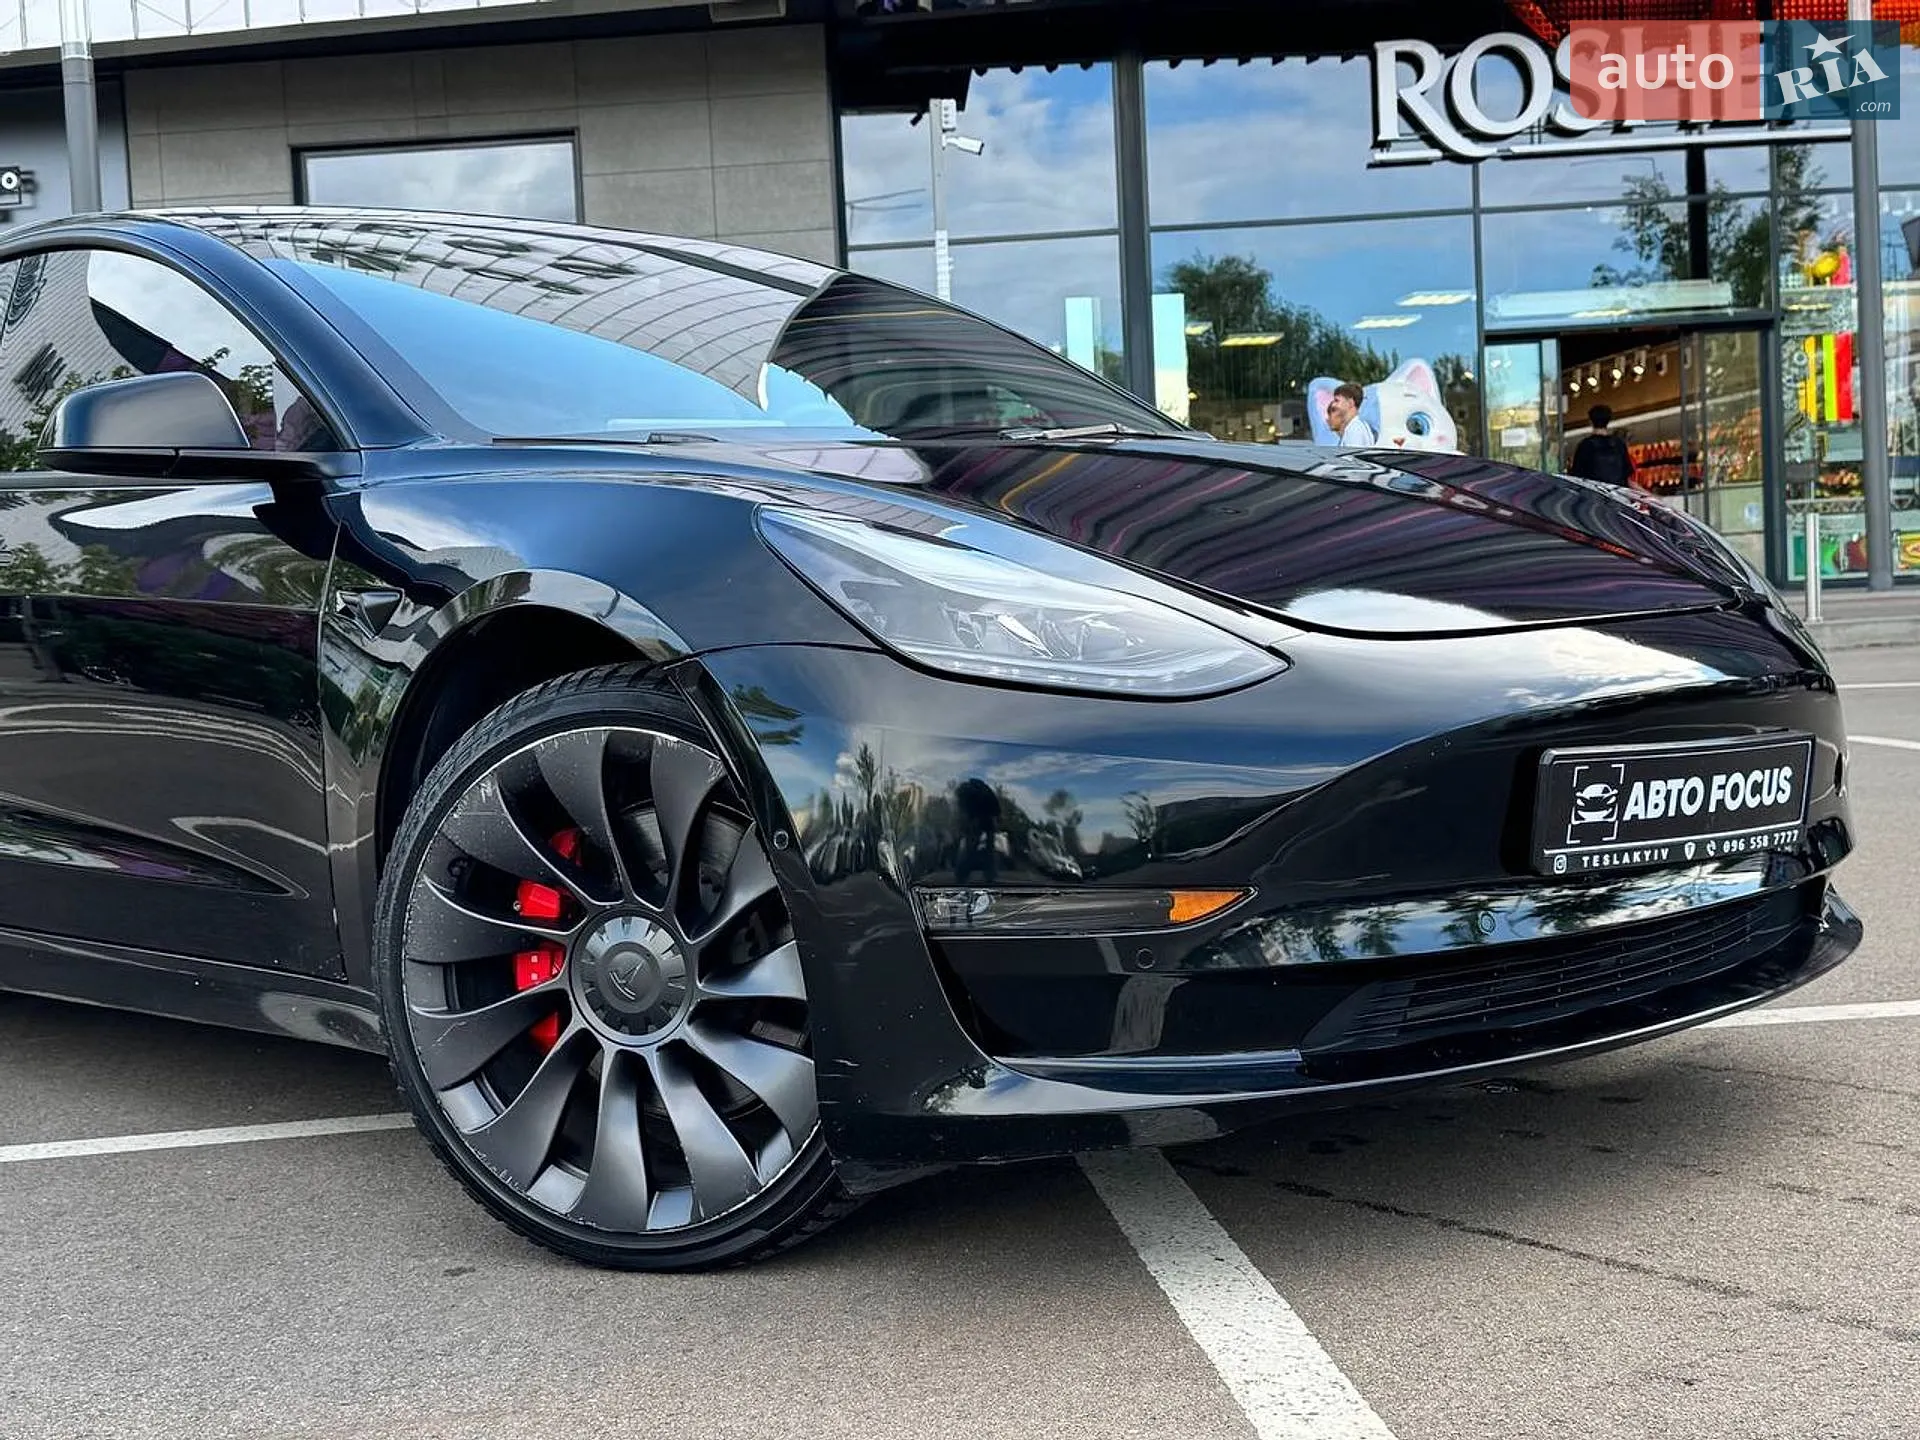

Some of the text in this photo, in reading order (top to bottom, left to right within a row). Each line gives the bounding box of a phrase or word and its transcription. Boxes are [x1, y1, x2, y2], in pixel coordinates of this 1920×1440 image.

[1623, 766, 1793, 821] АВТО FOCUS
[1581, 829, 1799, 868] TESLAKYIV 096 558 7777
